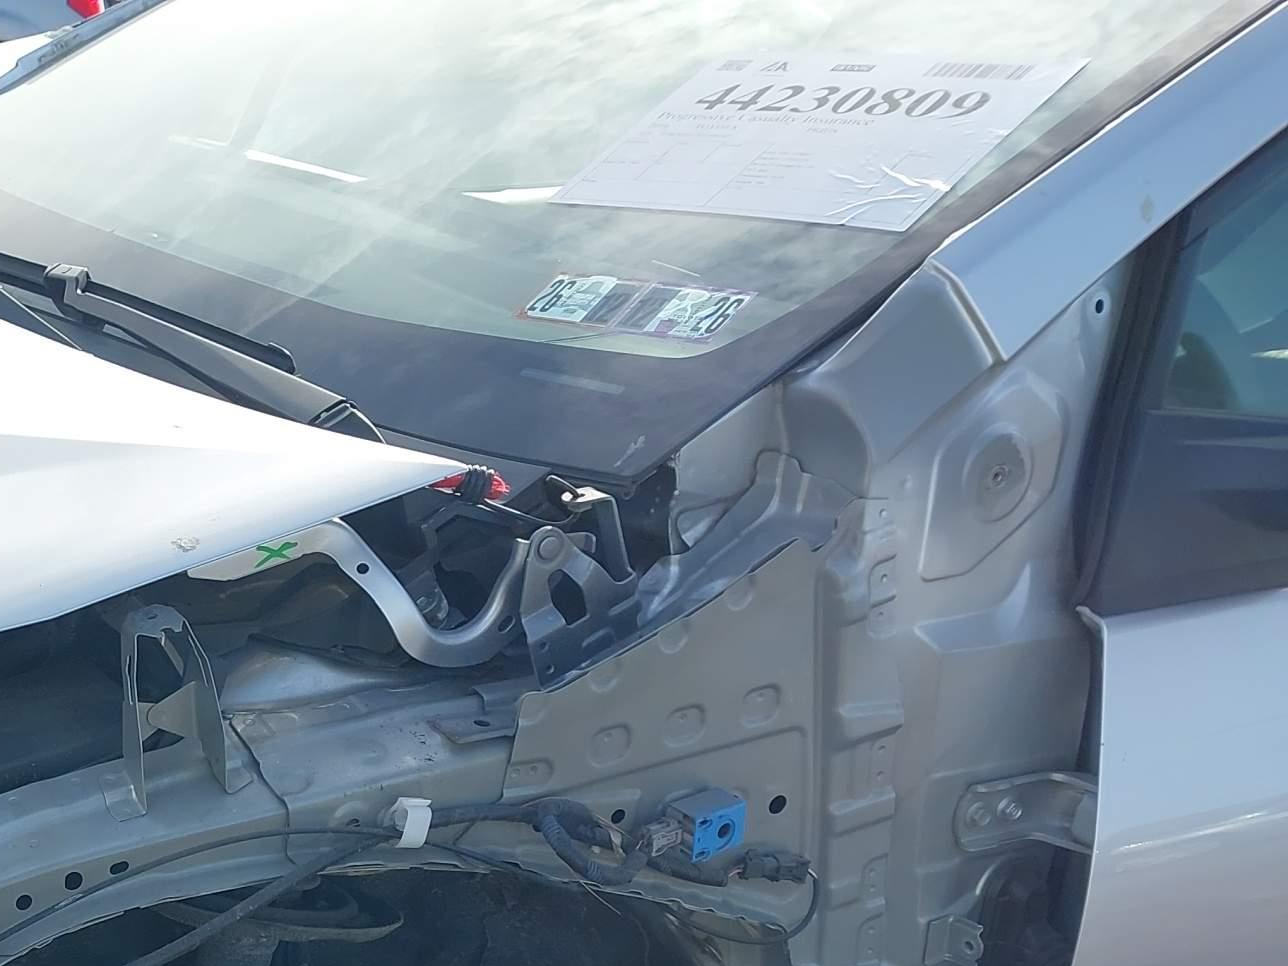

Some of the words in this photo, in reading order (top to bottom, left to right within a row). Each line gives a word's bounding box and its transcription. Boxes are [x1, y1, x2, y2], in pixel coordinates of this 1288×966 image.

[696, 83, 993, 119] 44230809
[802, 115, 876, 126] Insurance
[527, 279, 578, 312] 26
[690, 297, 745, 333] 26
